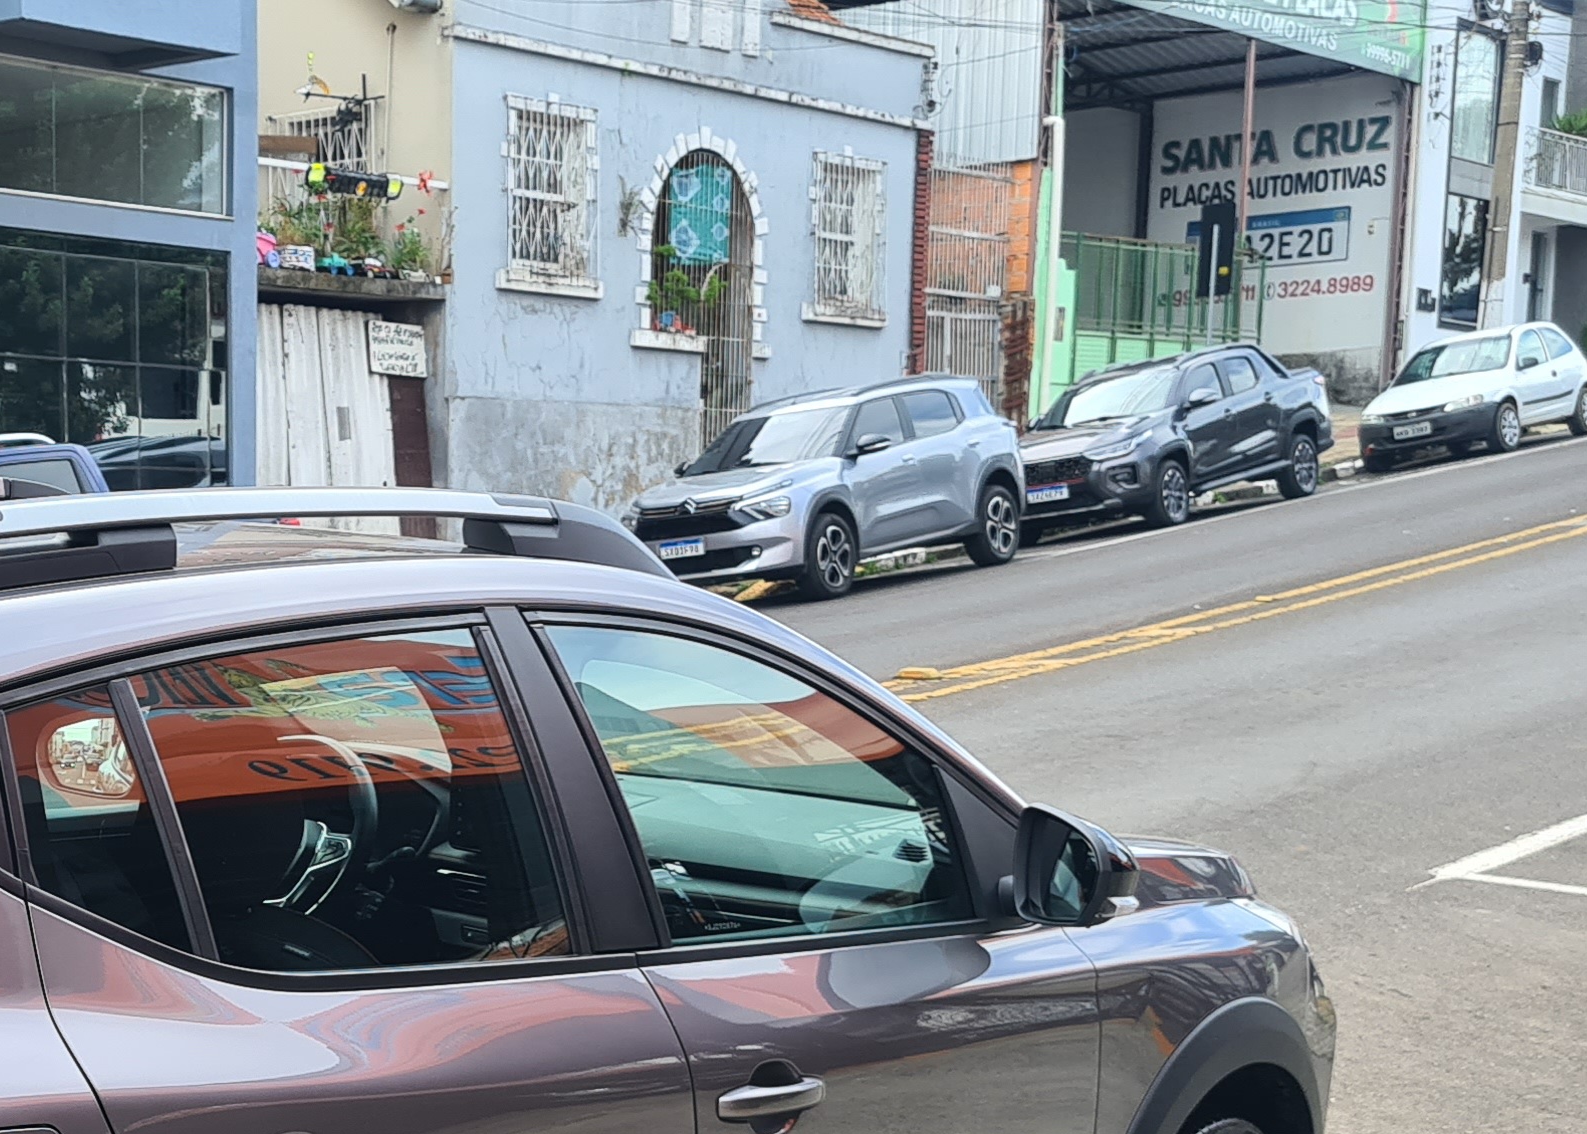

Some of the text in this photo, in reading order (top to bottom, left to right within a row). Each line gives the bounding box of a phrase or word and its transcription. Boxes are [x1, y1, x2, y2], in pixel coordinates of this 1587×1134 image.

[1229, 8, 1339, 51] AUTOMOTIVAS
[1160, 115, 1392, 175] SANTA CRUZ
[1159, 163, 1387, 209] PLACAS AUTOMOTIVAS
[1276, 274, 1375, 299] 3224.8989
